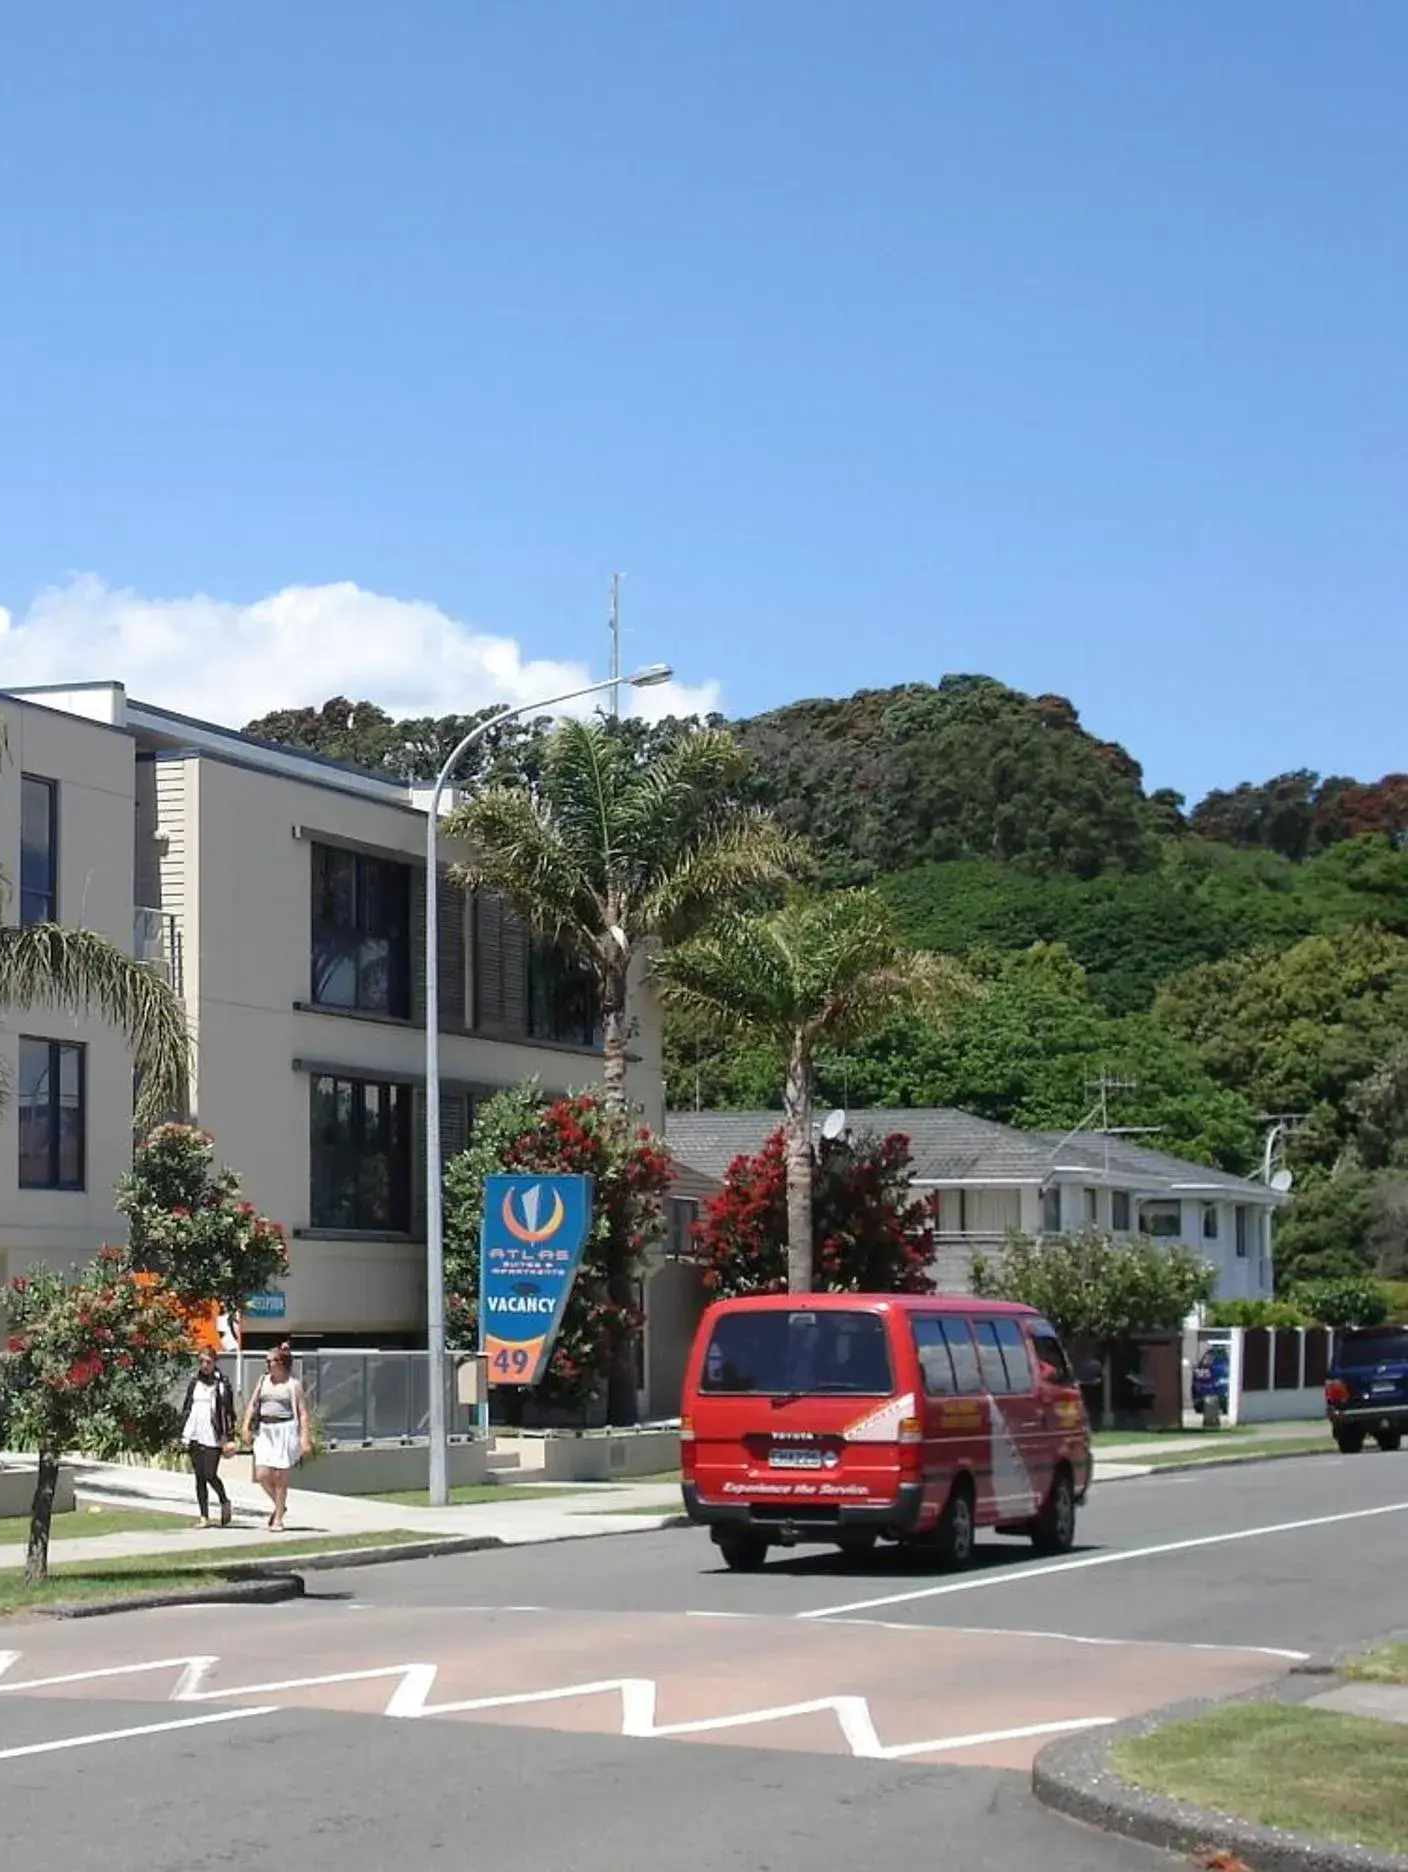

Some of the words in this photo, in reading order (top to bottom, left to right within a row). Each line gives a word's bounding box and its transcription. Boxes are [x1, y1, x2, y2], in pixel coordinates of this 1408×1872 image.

[488, 1248, 570, 1260] ATLAS
[487, 1297, 556, 1313] VACANCY
[494, 1349, 528, 1374] 49
[771, 1431, 814, 1440] TOYOTA
[723, 1482, 791, 1494] Experience
[793, 1484, 817, 1494] the
